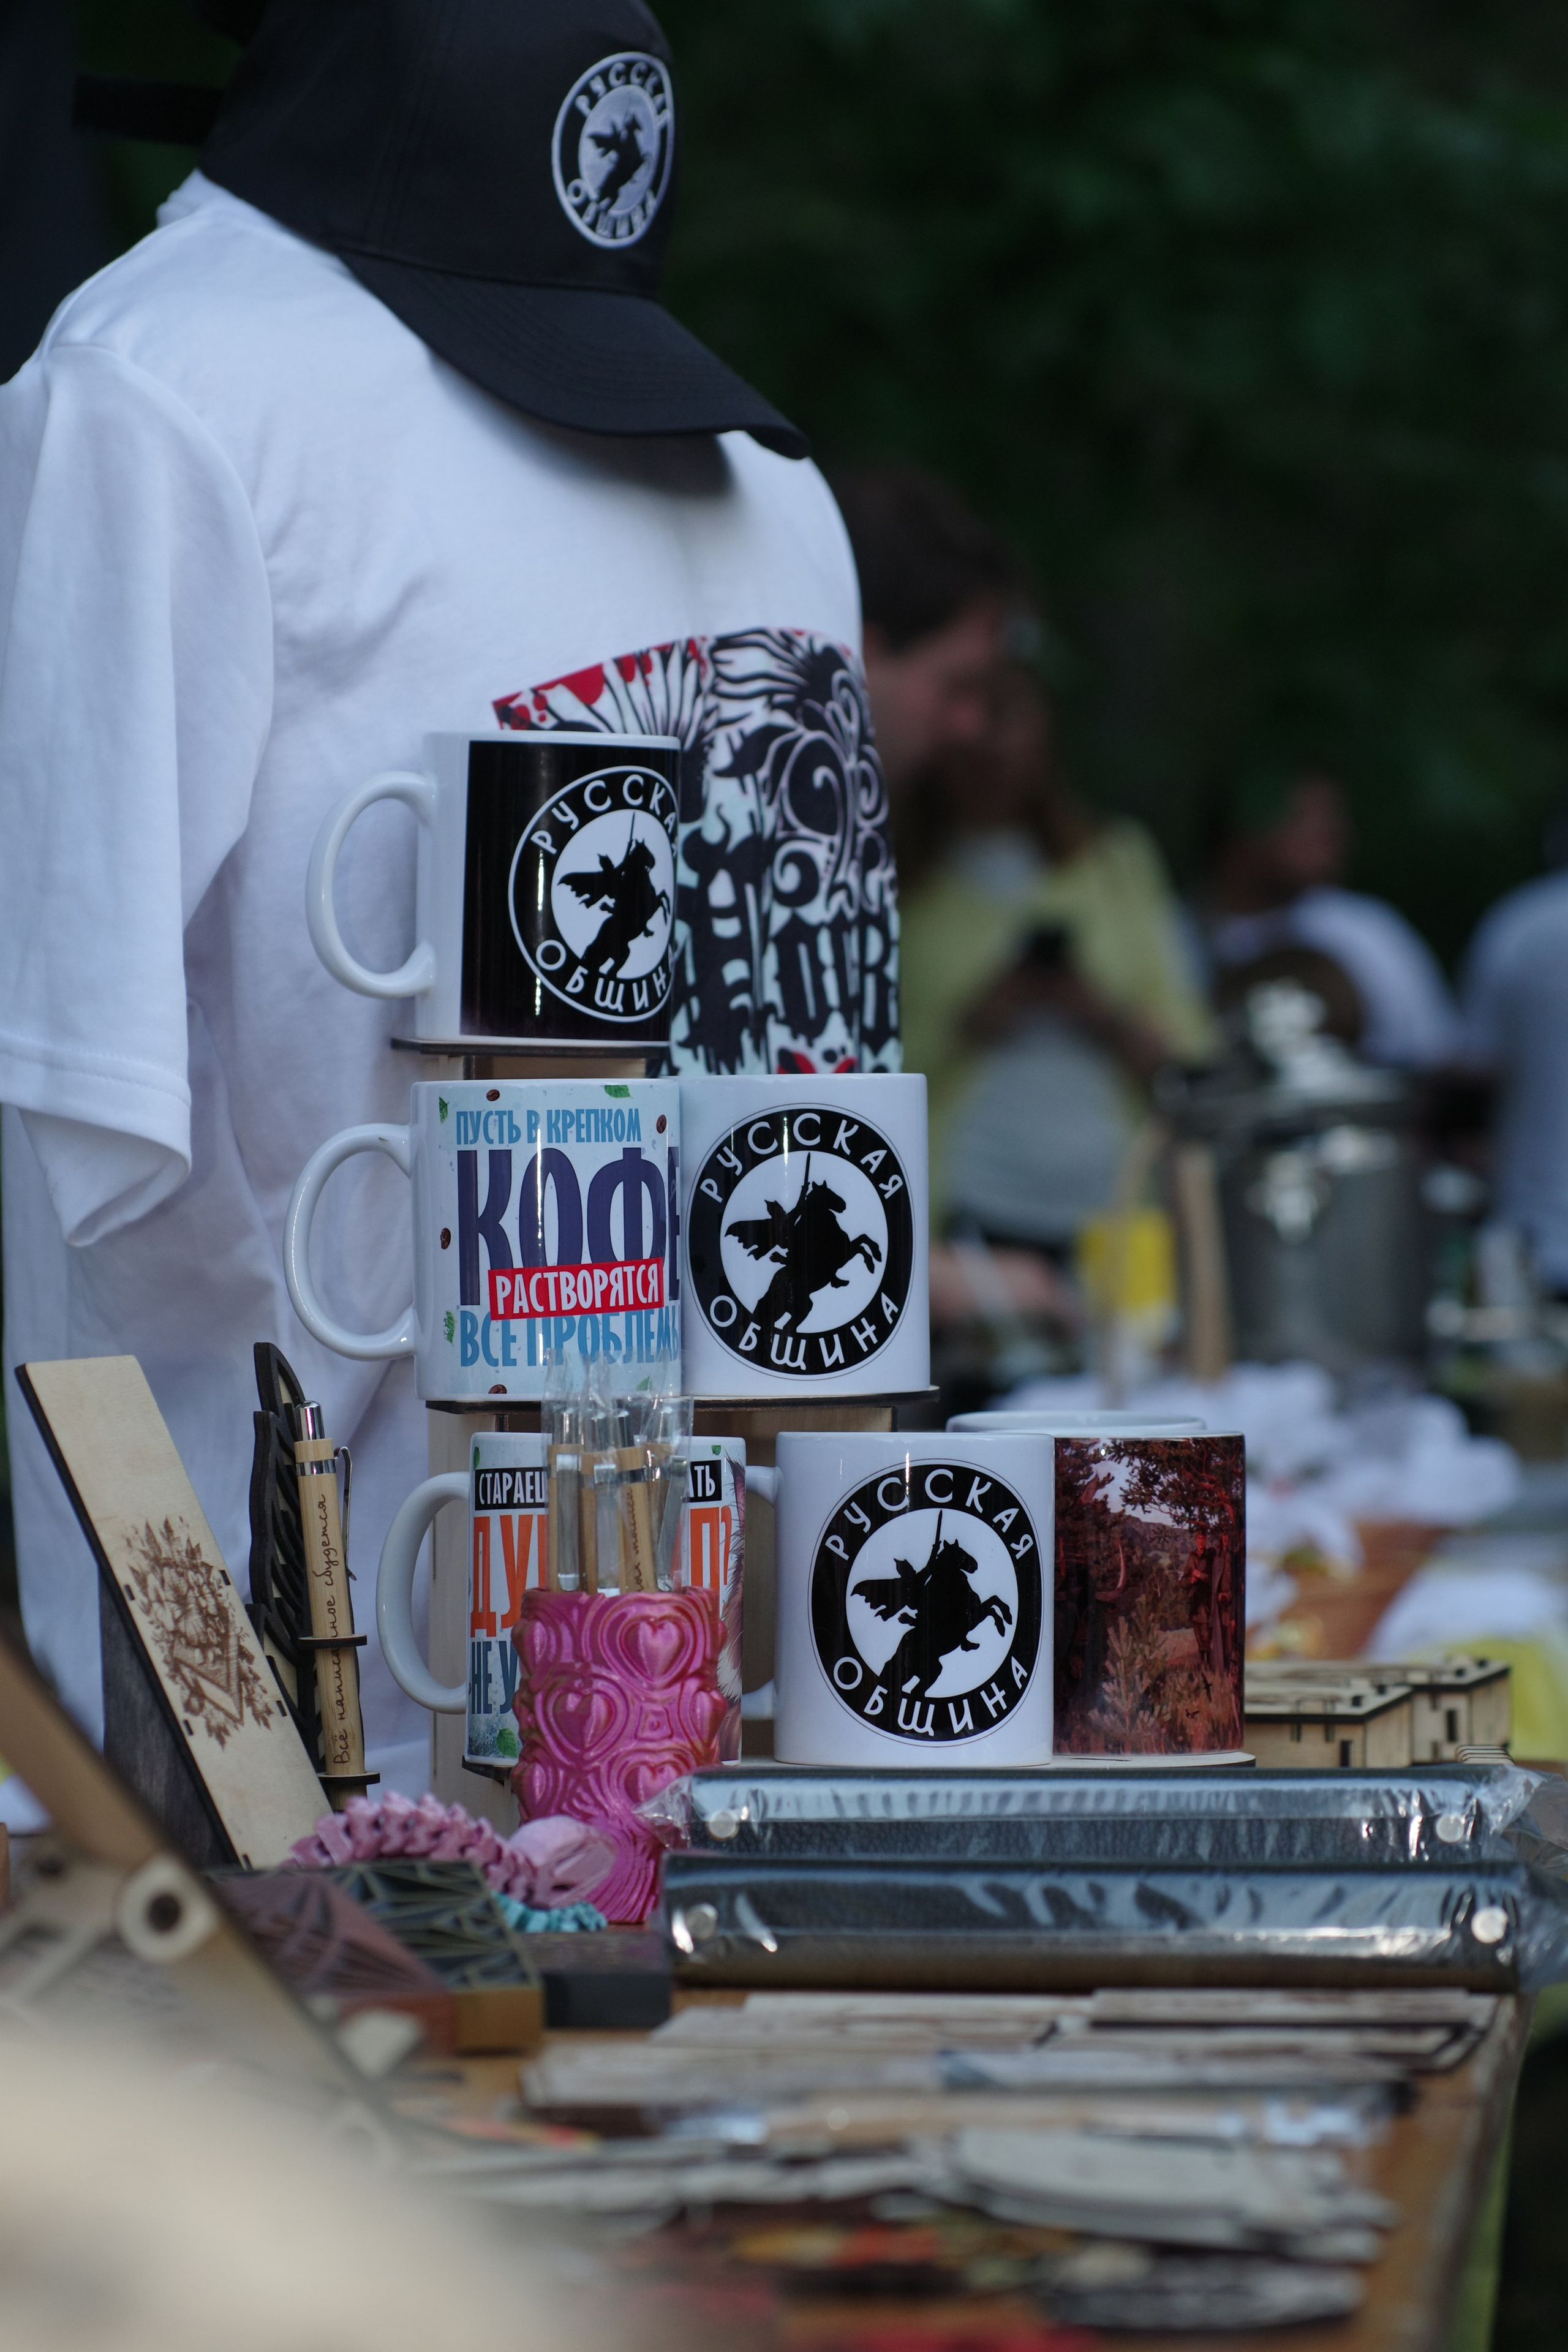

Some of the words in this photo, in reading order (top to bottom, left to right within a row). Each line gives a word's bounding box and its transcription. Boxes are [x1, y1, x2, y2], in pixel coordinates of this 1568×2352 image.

[456, 1110, 521, 1145] ПУСТЬ
[527, 1109, 540, 1144] В
[546, 1108, 642, 1144] КРЕПКОМ
[699, 1113, 903, 1203] РУССКАЯ
[495, 1262, 659, 1315] РАСТВОРЯТСЯ
[459, 1310, 517, 1367] ВСЕ
[710, 1292, 899, 1370] ОБЩИНА
[312, 1494, 339, 1586] сбудется
[824, 1469, 1034, 1561] РУССКАЯ
[471, 1640, 492, 1715] НЕ
[833, 1656, 1028, 1736] ОБЩИНА
[333, 1728, 350, 1764] Всё
